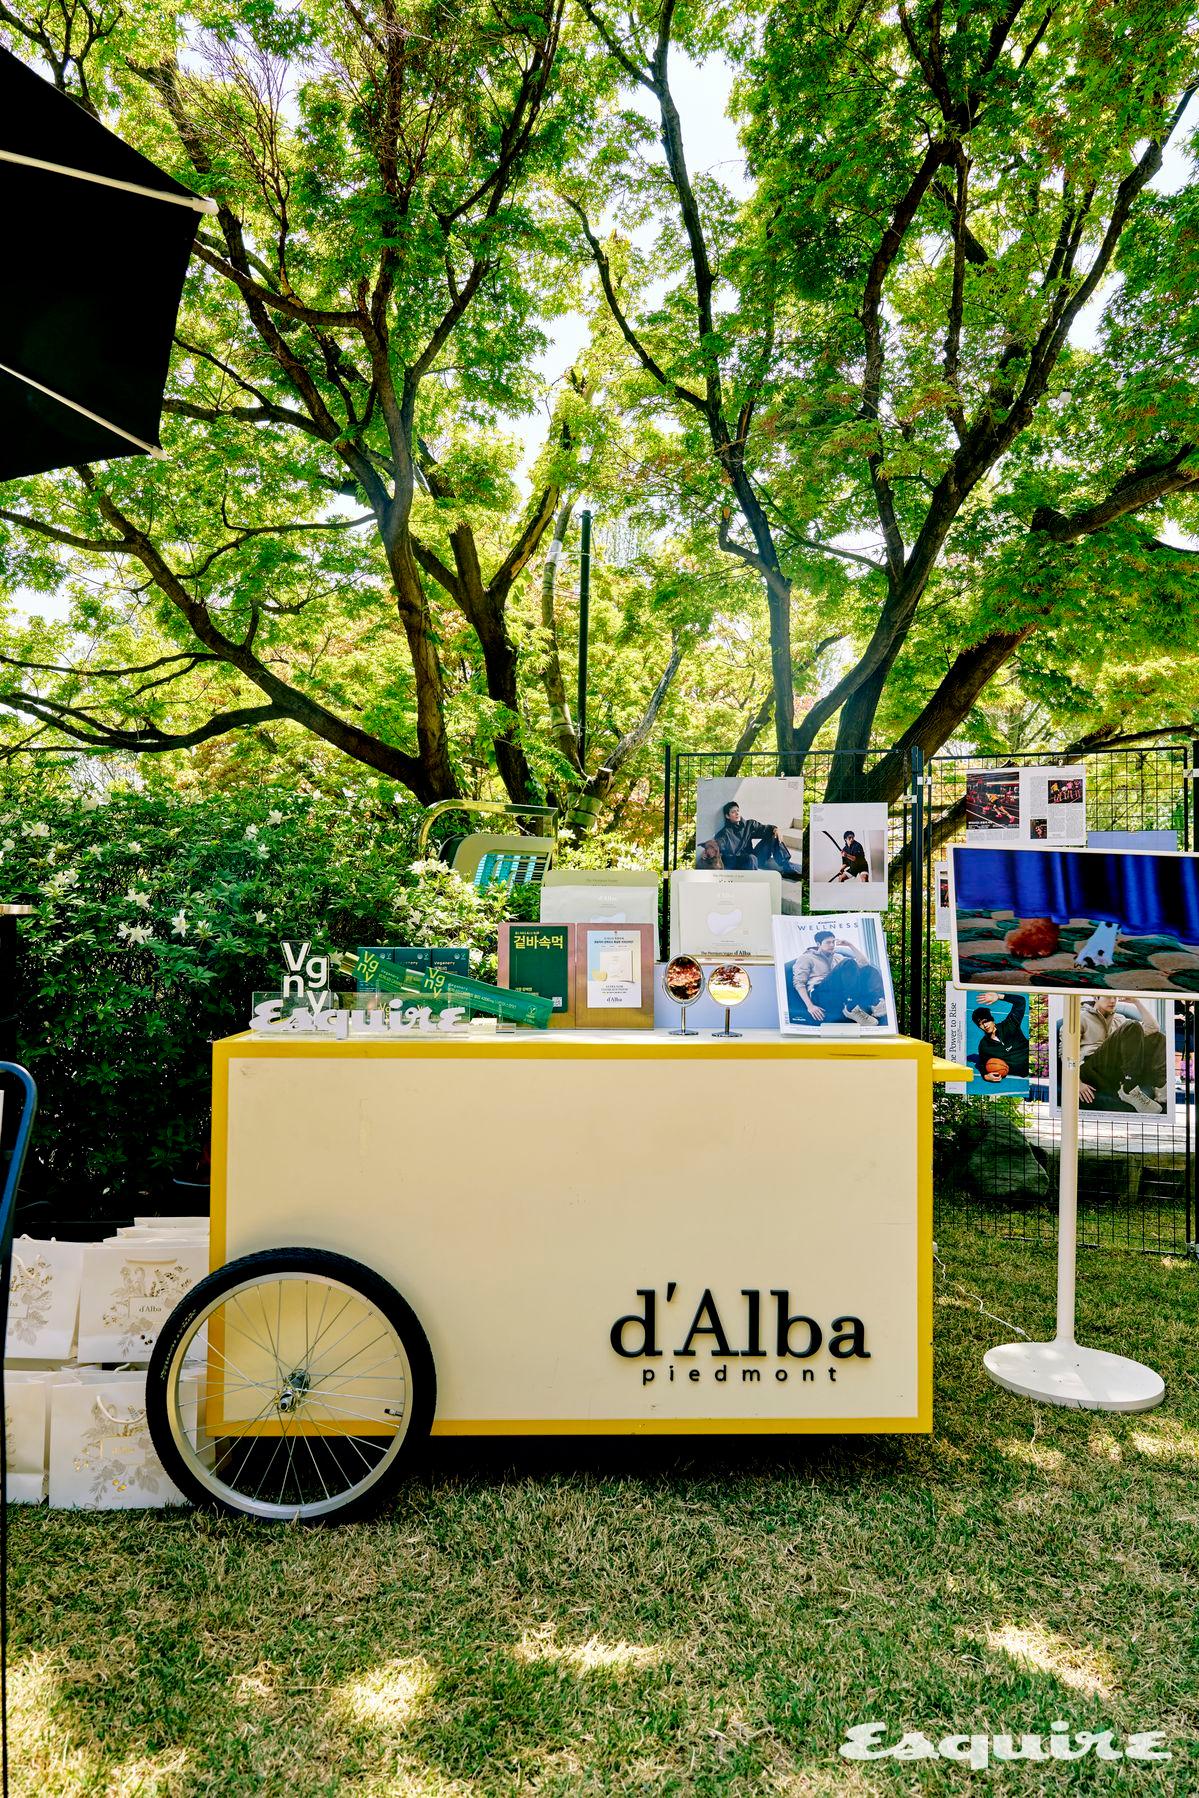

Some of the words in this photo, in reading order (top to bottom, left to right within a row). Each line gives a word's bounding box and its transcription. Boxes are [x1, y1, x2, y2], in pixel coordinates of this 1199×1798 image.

[797, 922, 859, 931] WELLNESS
[513, 935, 563, 949] 겉바속먹
[949, 1002, 957, 1018] Rise
[249, 998, 467, 1040] Esquire
[950, 1020, 957, 1028] to
[949, 1029, 957, 1053] Power
[138, 1305, 162, 1313] d'Alba
[609, 1282, 872, 1359] d'Alba
[642, 1364, 838, 1386] piedmont
